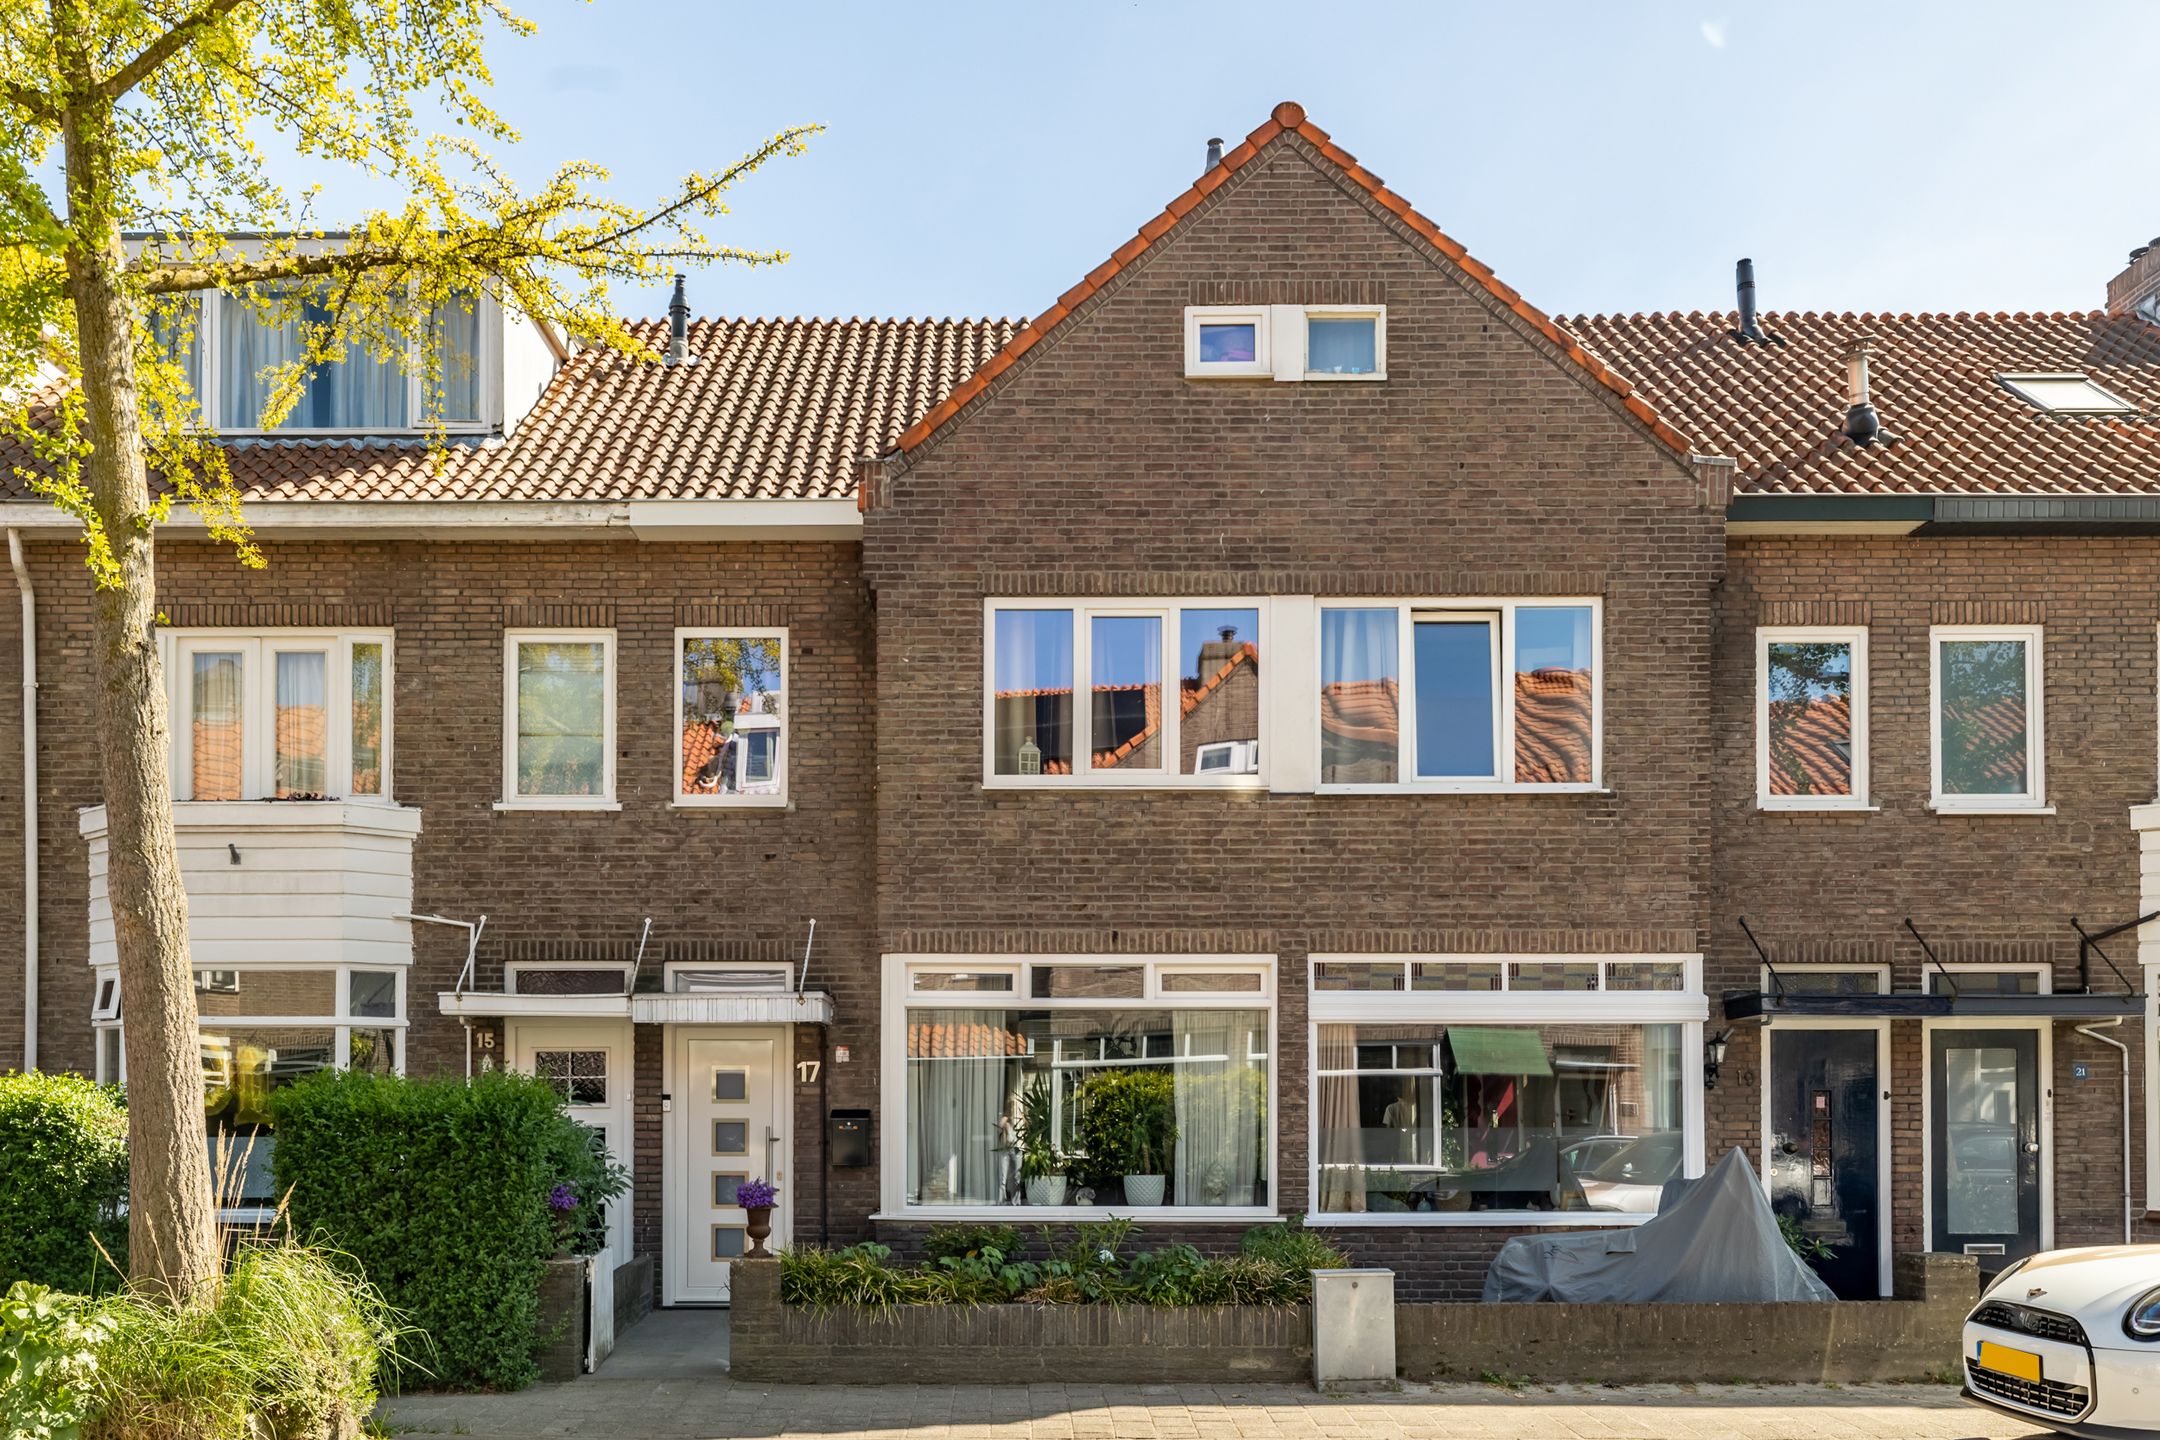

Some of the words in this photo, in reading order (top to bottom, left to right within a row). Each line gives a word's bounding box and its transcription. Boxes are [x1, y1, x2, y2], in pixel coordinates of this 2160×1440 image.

[476, 1032, 495, 1049] 15
[796, 1060, 821, 1083] 17
[1736, 1068, 1754, 1087] 19
[2075, 1066, 2086, 1077] 21
